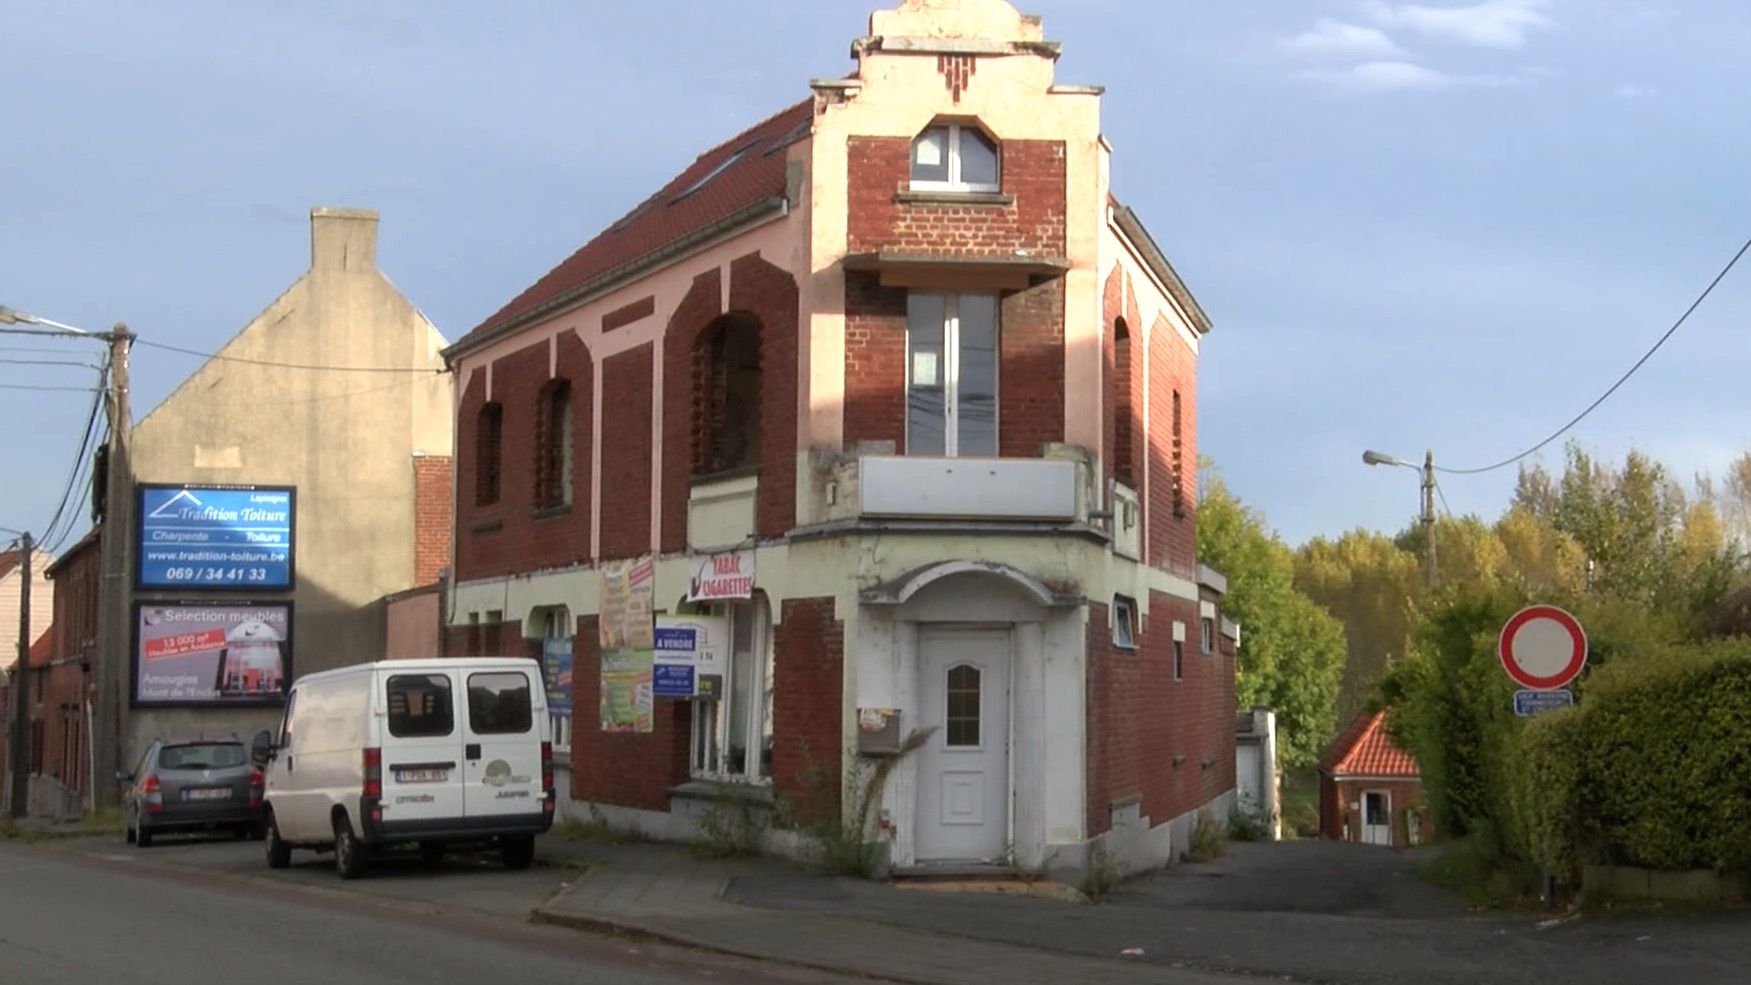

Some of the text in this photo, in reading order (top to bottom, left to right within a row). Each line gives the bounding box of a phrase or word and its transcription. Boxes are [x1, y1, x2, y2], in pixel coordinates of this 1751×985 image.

[178, 506, 286, 522] Tradition Toiture
[152, 530, 209, 542] Charpente
[246, 531, 281, 543] Toiture
[148, 551, 284, 562] www.tradition-toiture.be
[712, 555, 741, 575] TABAC
[166, 567, 193, 580] 069
[206, 568, 223, 580] 34
[227, 568, 244, 580] 41
[249, 568, 266, 580] 33
[703, 576, 753, 597] CIGARETTES
[165, 609, 284, 623] Selection meubles
[177, 634, 196, 645] 000
[664, 638, 693, 649] VENDRE
[143, 674, 198, 686] Amougies
[170, 687, 184, 697] de
